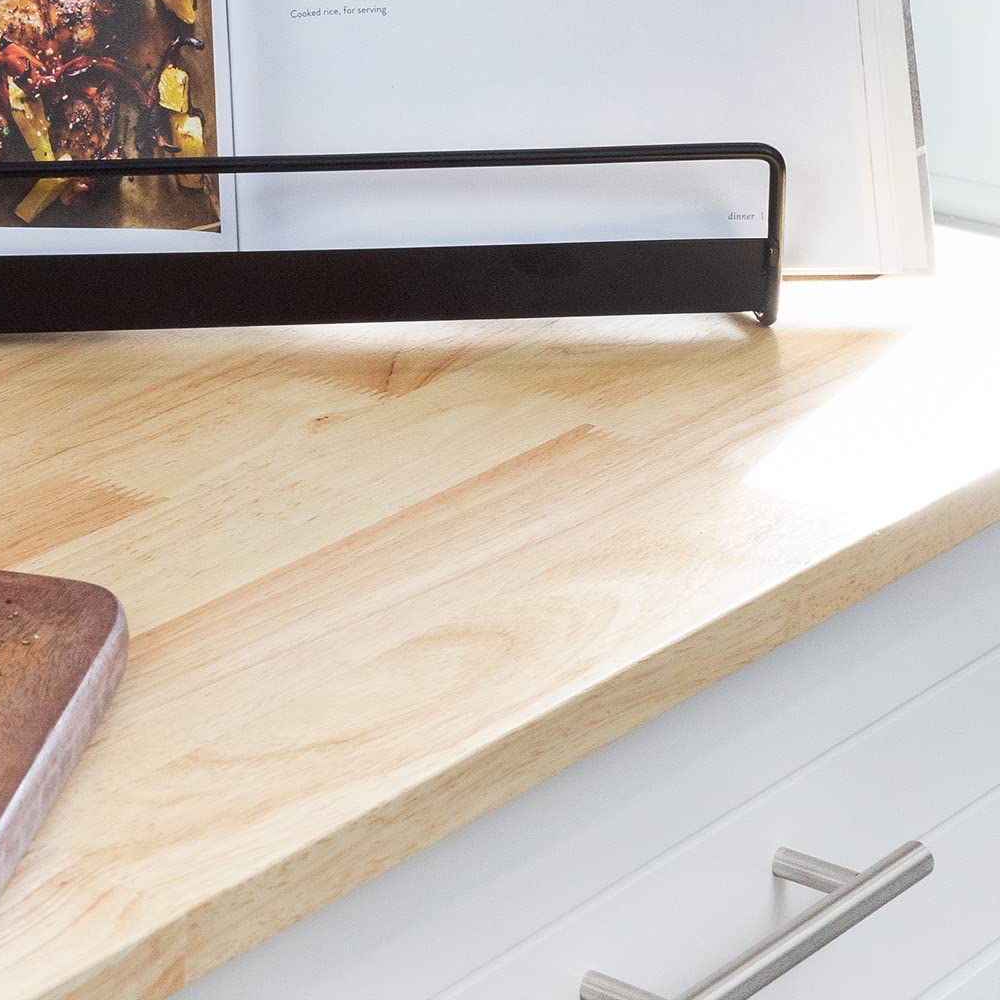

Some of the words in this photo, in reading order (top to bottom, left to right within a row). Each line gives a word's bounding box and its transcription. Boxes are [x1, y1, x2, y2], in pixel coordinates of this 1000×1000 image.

[290, 7, 322, 19] Cooked
[323, 7, 342, 16] rice,
[343, 5, 355, 15] for
[357, 5, 387, 17] serving
[728, 212, 755, 220] dinner
